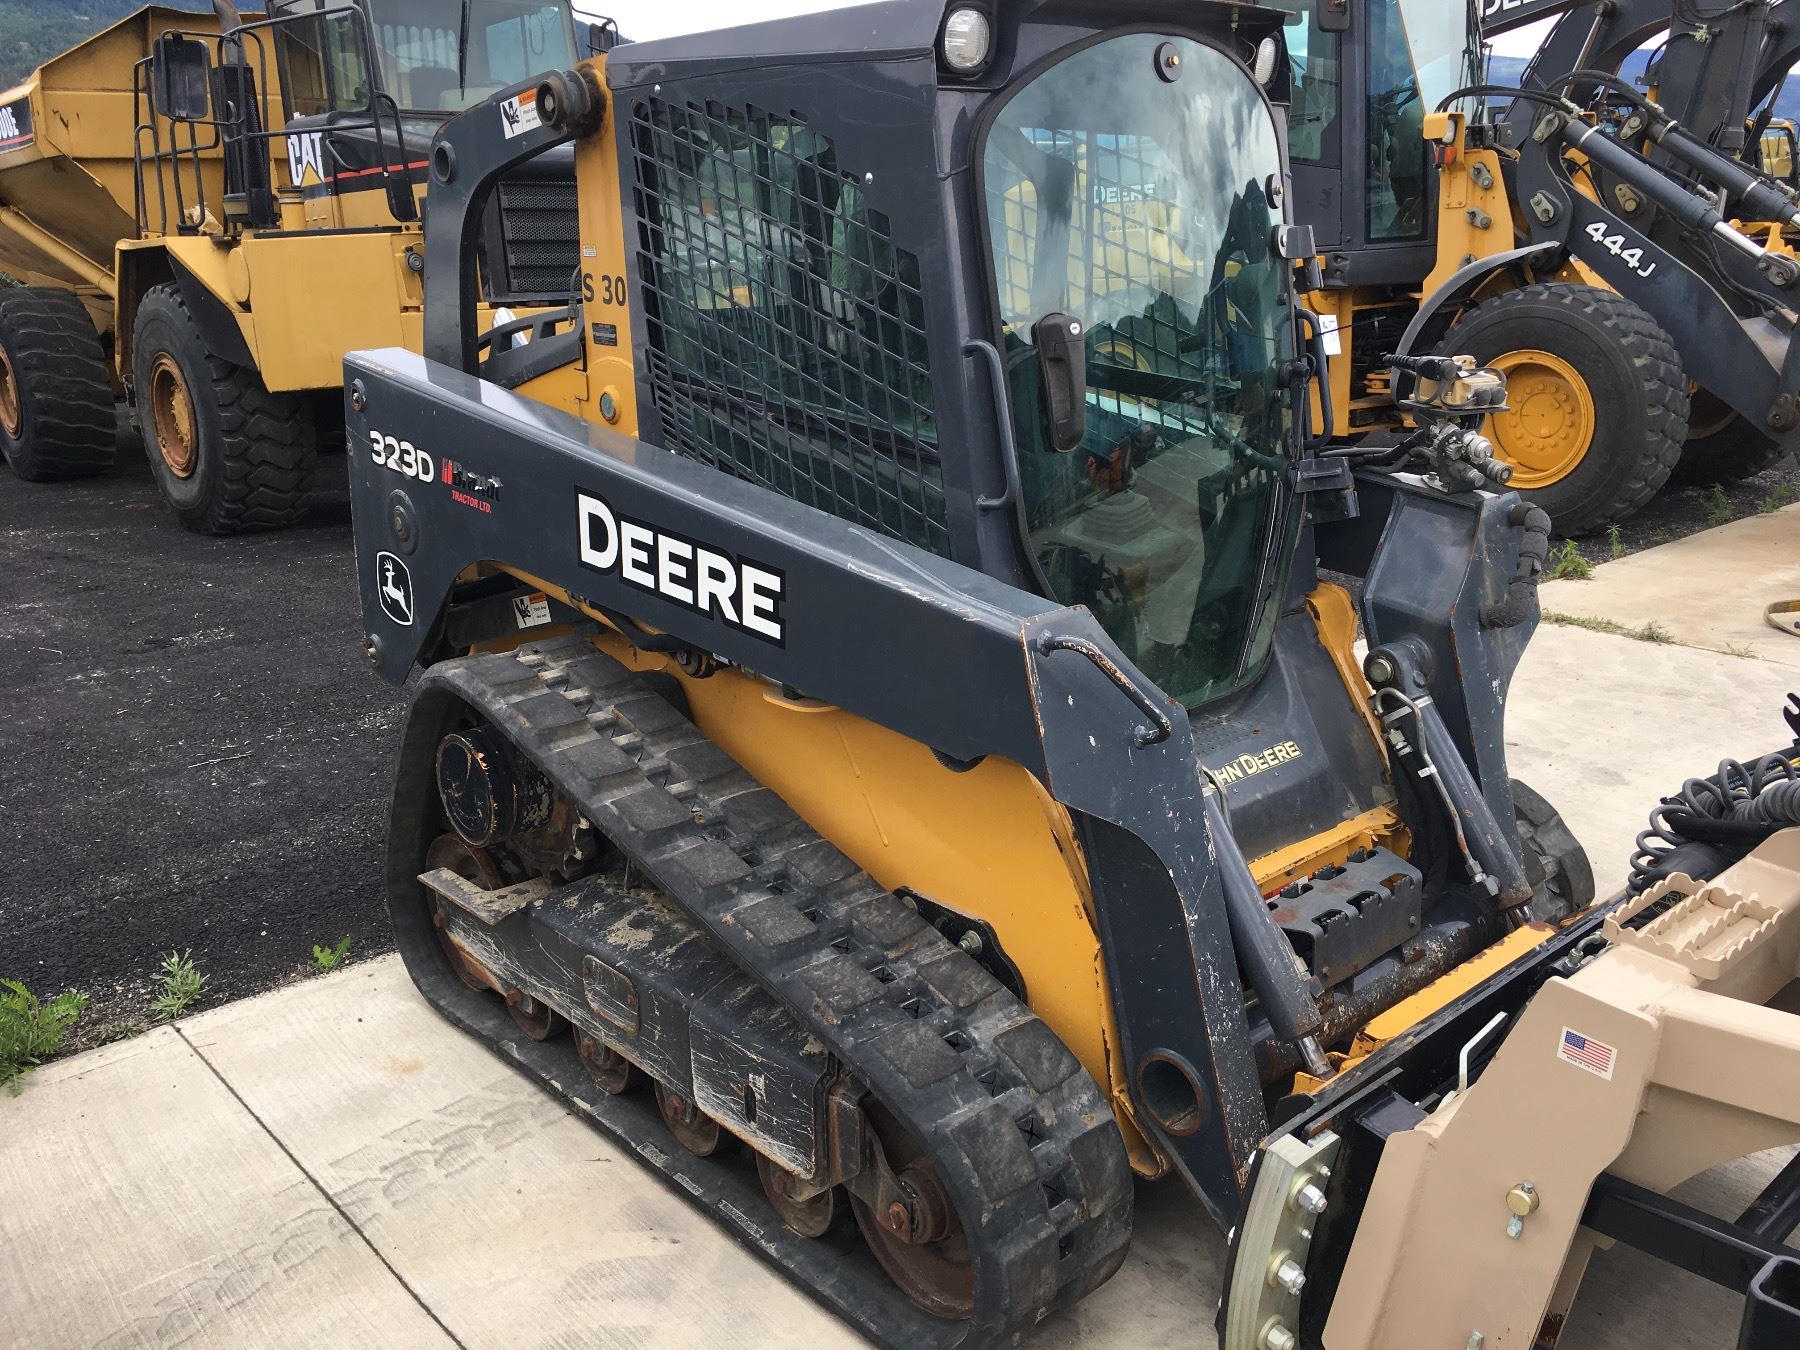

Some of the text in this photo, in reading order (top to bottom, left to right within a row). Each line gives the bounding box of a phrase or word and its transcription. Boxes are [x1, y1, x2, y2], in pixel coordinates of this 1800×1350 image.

[0, 106, 20, 140] 00E
[287, 132, 325, 186] CAT
[1585, 222, 1656, 277] 444J
[582, 273, 626, 306] S 30
[369, 430, 435, 483] 323D
[451, 489, 479, 509] TRACTOR
[578, 493, 781, 640] DEERE
[1213, 740, 1301, 786] HN DEERE
